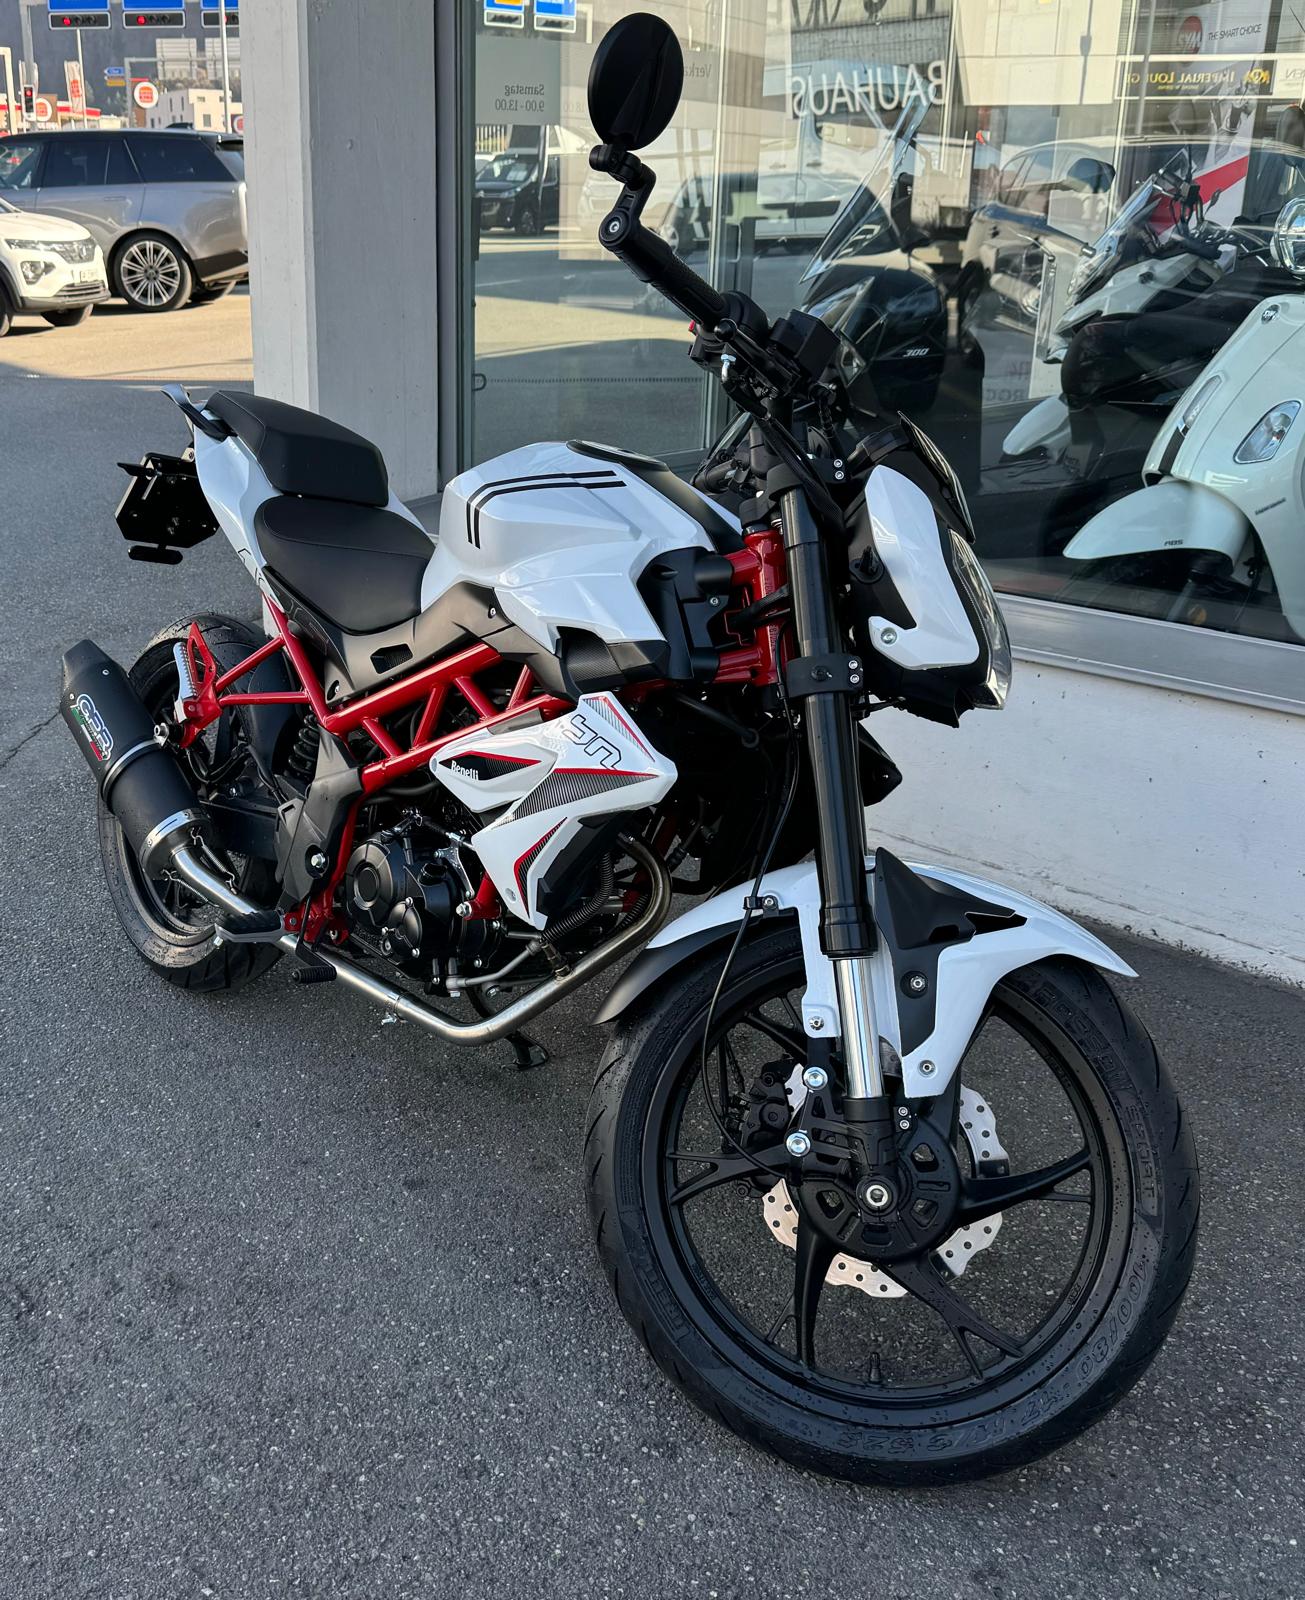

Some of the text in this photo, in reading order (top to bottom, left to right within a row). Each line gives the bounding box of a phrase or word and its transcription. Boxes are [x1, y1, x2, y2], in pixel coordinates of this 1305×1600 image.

[1208, 24, 1262, 41] THE SMART CHOICE
[902, 347, 930, 358] 300
[77, 694, 113, 754] GPR
[451, 760, 479, 781] Benelli
